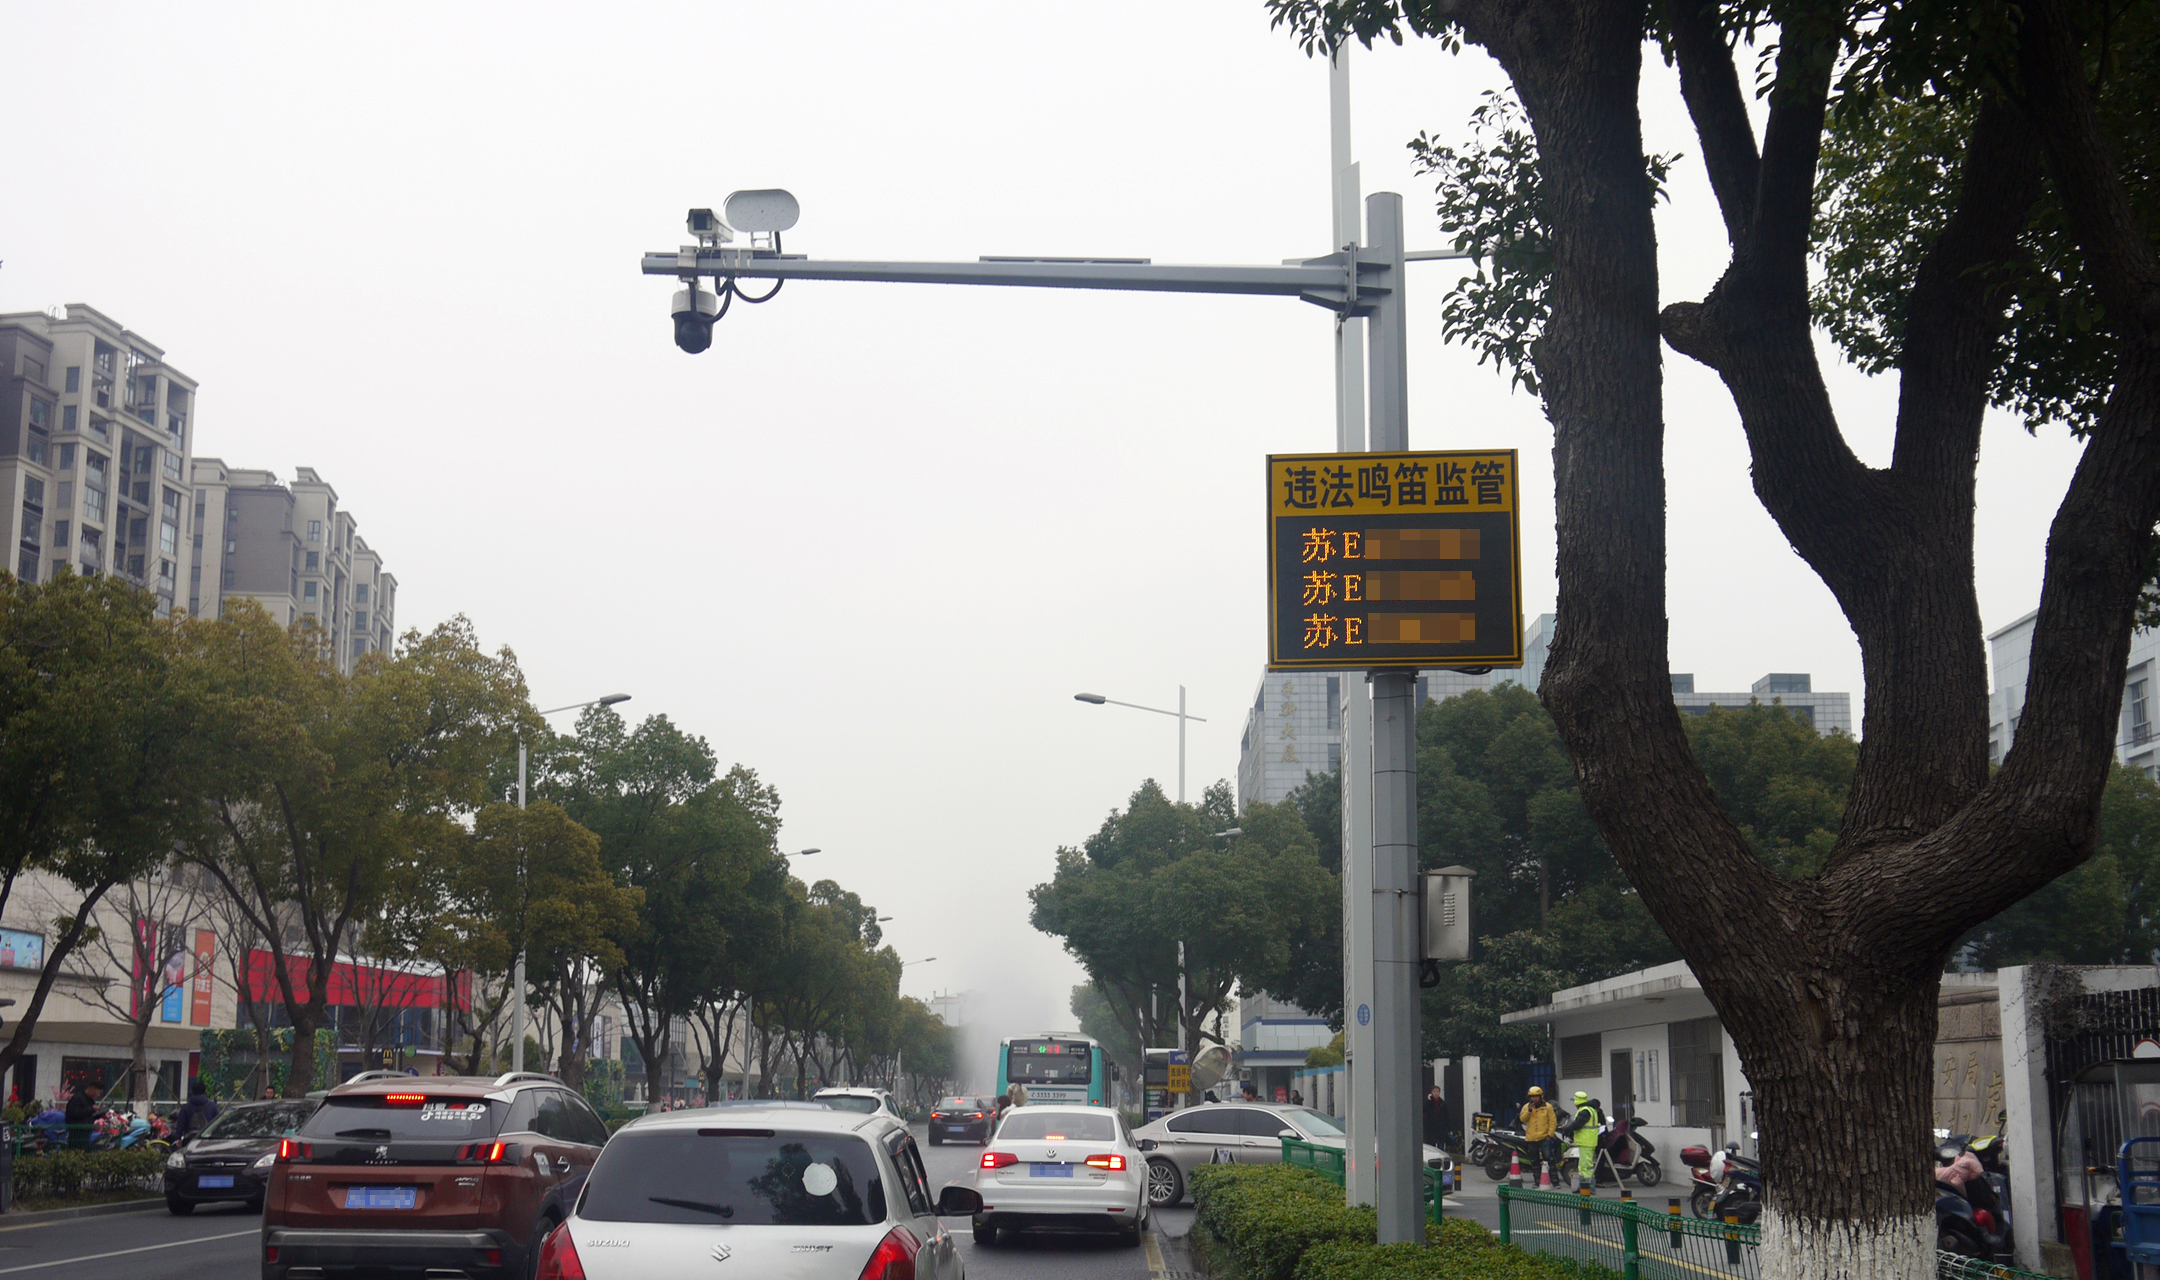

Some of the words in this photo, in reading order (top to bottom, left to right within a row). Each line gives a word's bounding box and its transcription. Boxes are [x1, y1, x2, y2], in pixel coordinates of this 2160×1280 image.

[1284, 461, 1505, 509] 违法鸣笛监管
[587, 1239, 630, 1248] SUZUKI
[791, 1245, 833, 1253] SWIFT
